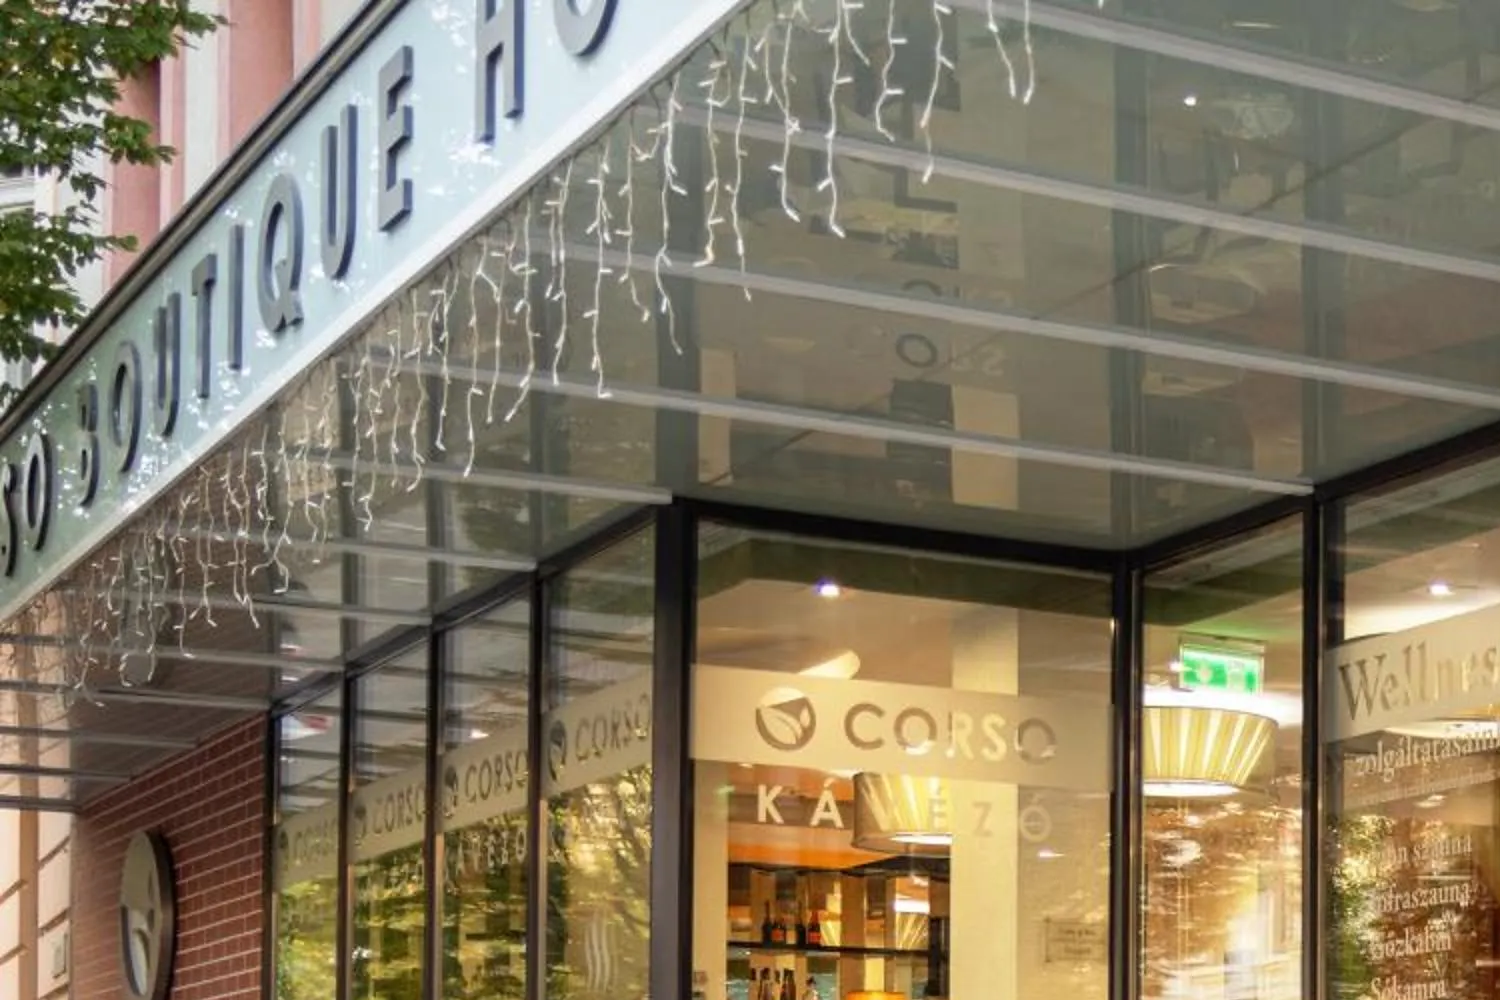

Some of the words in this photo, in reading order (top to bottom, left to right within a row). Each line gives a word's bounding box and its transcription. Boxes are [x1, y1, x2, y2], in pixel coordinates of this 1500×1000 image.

[77, 45, 413, 507] BOUTIQUE
[844, 702, 1058, 765] CORSO
[756, 776, 1053, 843] KÁÉZÓ
